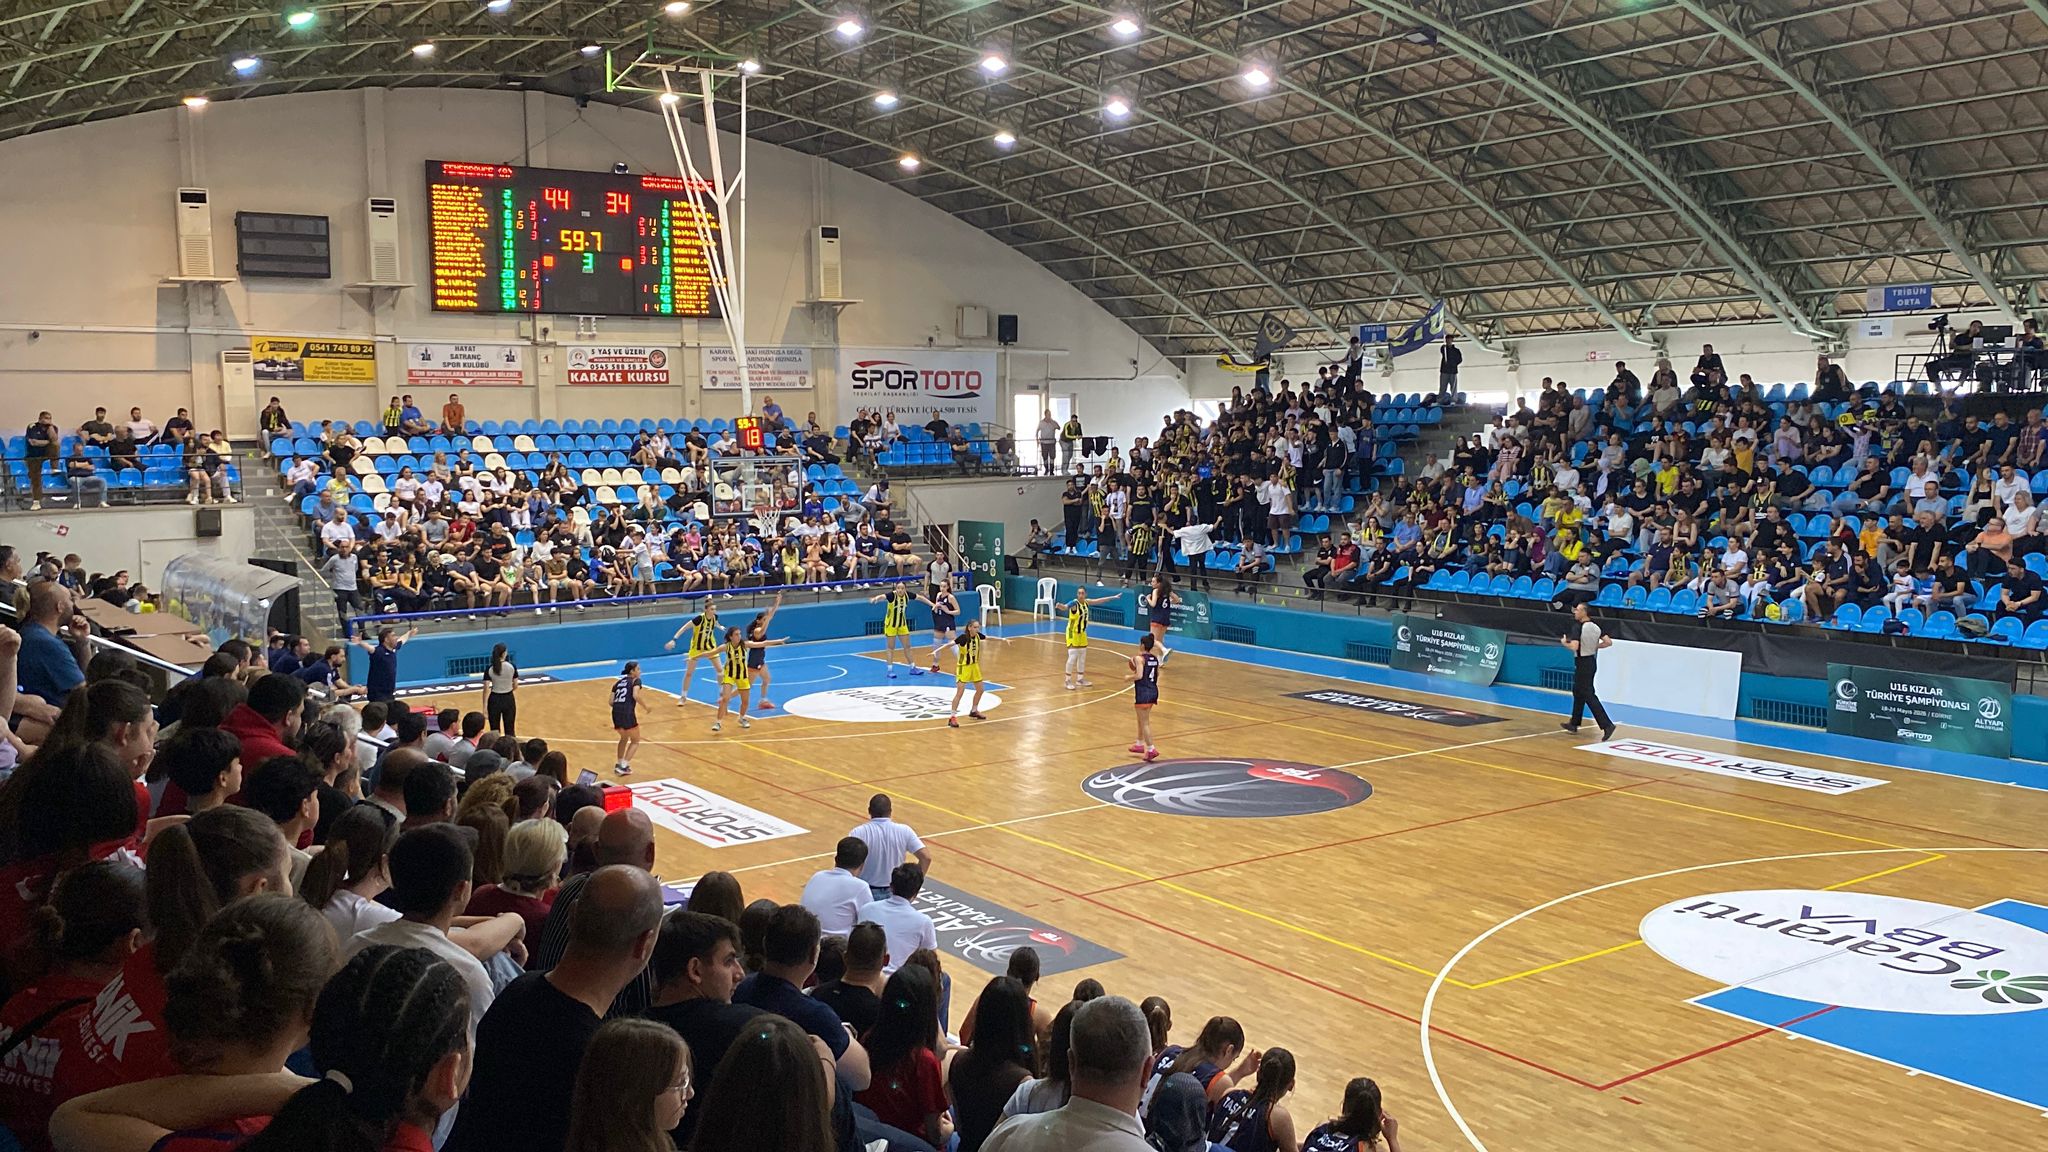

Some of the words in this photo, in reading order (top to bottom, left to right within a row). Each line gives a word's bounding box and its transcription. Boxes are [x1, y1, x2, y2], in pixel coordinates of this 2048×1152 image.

[545, 188, 570, 210] 44
[606, 192, 631, 214] 34
[649, 217, 657, 227] 11
[560, 229, 602, 252] 59.7
[582, 252, 594, 268] 3
[519, 289, 527, 299] 12
[1892, 287, 1927, 297] TRİBÜN
[309, 343, 330, 351] 0541
[332, 344, 348, 352] 749
[362, 345, 373, 353] 24
[624, 347, 646, 355] ÜZERİ
[570, 372, 623, 382] KARATE
[627, 372, 667, 382] KURSU
[851, 369, 982, 390] SPORTOTO
[886, 405, 920, 414] TÜRKİYE
[957, 405, 978, 414] TESİS
[747, 429, 760, 445] 18
[1161, 598, 1168, 608] 6
[1431, 629, 1444, 637] U16
[1444, 630, 1466, 641] KIZLAR
[1415, 634, 1441, 645] TÜRKİYE
[1440, 639, 1480, 653] ŞAMPİYONASI
[1148, 667, 1156, 682] 4
[614, 688, 628, 702] 22
[1890, 682, 1908, 692] U16
[1909, 684, 1943, 696] KIZLAR
[1865, 689, 1904, 702] TÜRKİYE
[1905, 695, 1970, 711] ŞAMPİYONASI
[1975, 718, 2004, 727] ALTYAPI
[1609, 743, 1862, 788] SPORTOTO
[632, 785, 773, 841] SPORTOTO
[1673, 900, 1962, 976] Garanti
[1799, 905, 2006, 961] BBVA
